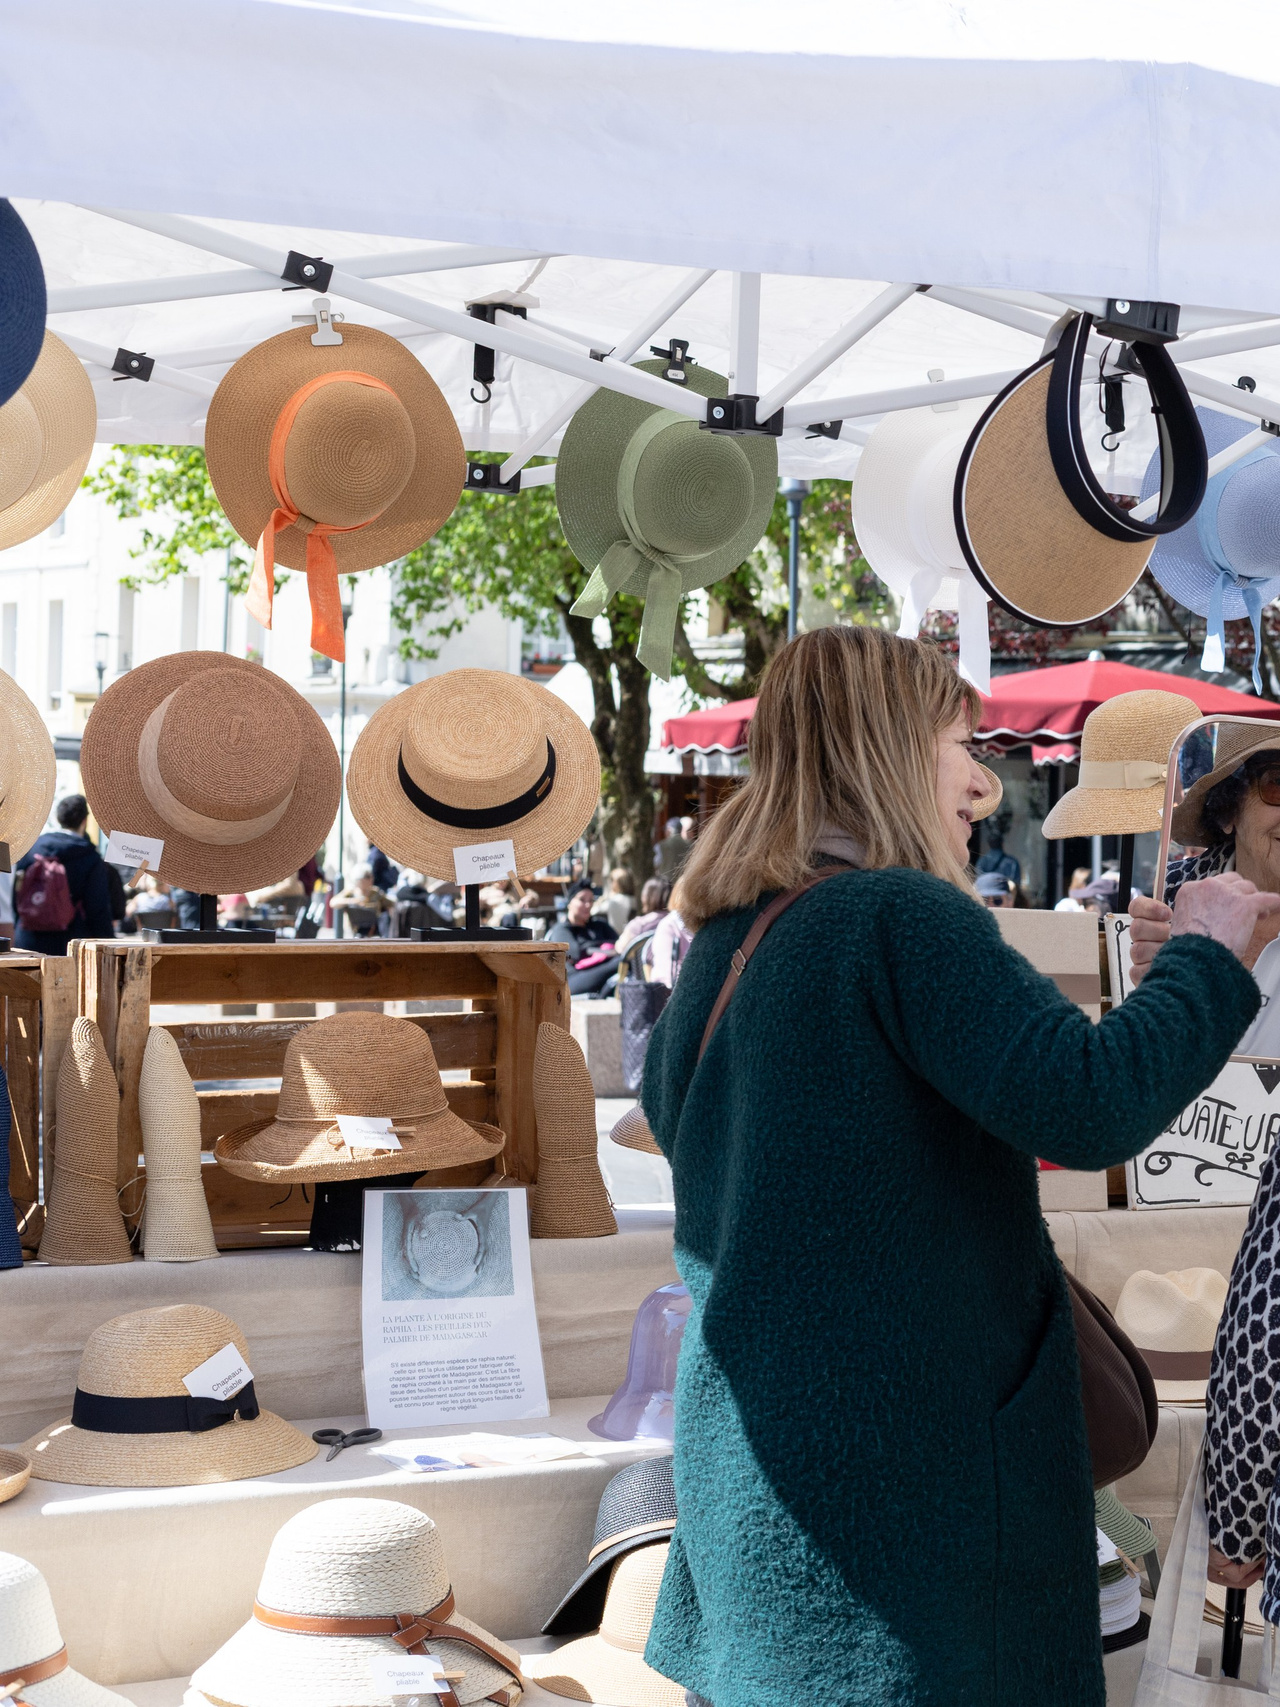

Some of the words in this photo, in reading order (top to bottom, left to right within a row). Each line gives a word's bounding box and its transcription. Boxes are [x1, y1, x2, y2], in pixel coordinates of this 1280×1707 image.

[121, 845, 150, 855] Chapeaux
[471, 853, 505, 863] Chapeaux
[479, 862, 500, 871] pliable
[394, 1315, 425, 1323] PLANTE
[426, 1313, 431, 1321] À
[434, 1312, 474, 1321] L'ORIGINE
[383, 1326, 413, 1334] RAPHIA
[417, 1324, 433, 1332] LES
[434, 1322, 471, 1331] FEUILLES
[473, 1321, 492, 1329] D'UN
[383, 1335, 418, 1344] PALMIER
[432, 1331, 488, 1341] MADAGASCAR
[417, 1359, 445, 1367] différentes
[446, 1357, 469, 1365] espèces
[211, 1367, 243, 1392] Chapeaux
[222, 1378, 243, 1396] pliable
[480, 1381, 513, 1389] Madagascar
[472, 1396, 493, 1404] longues
